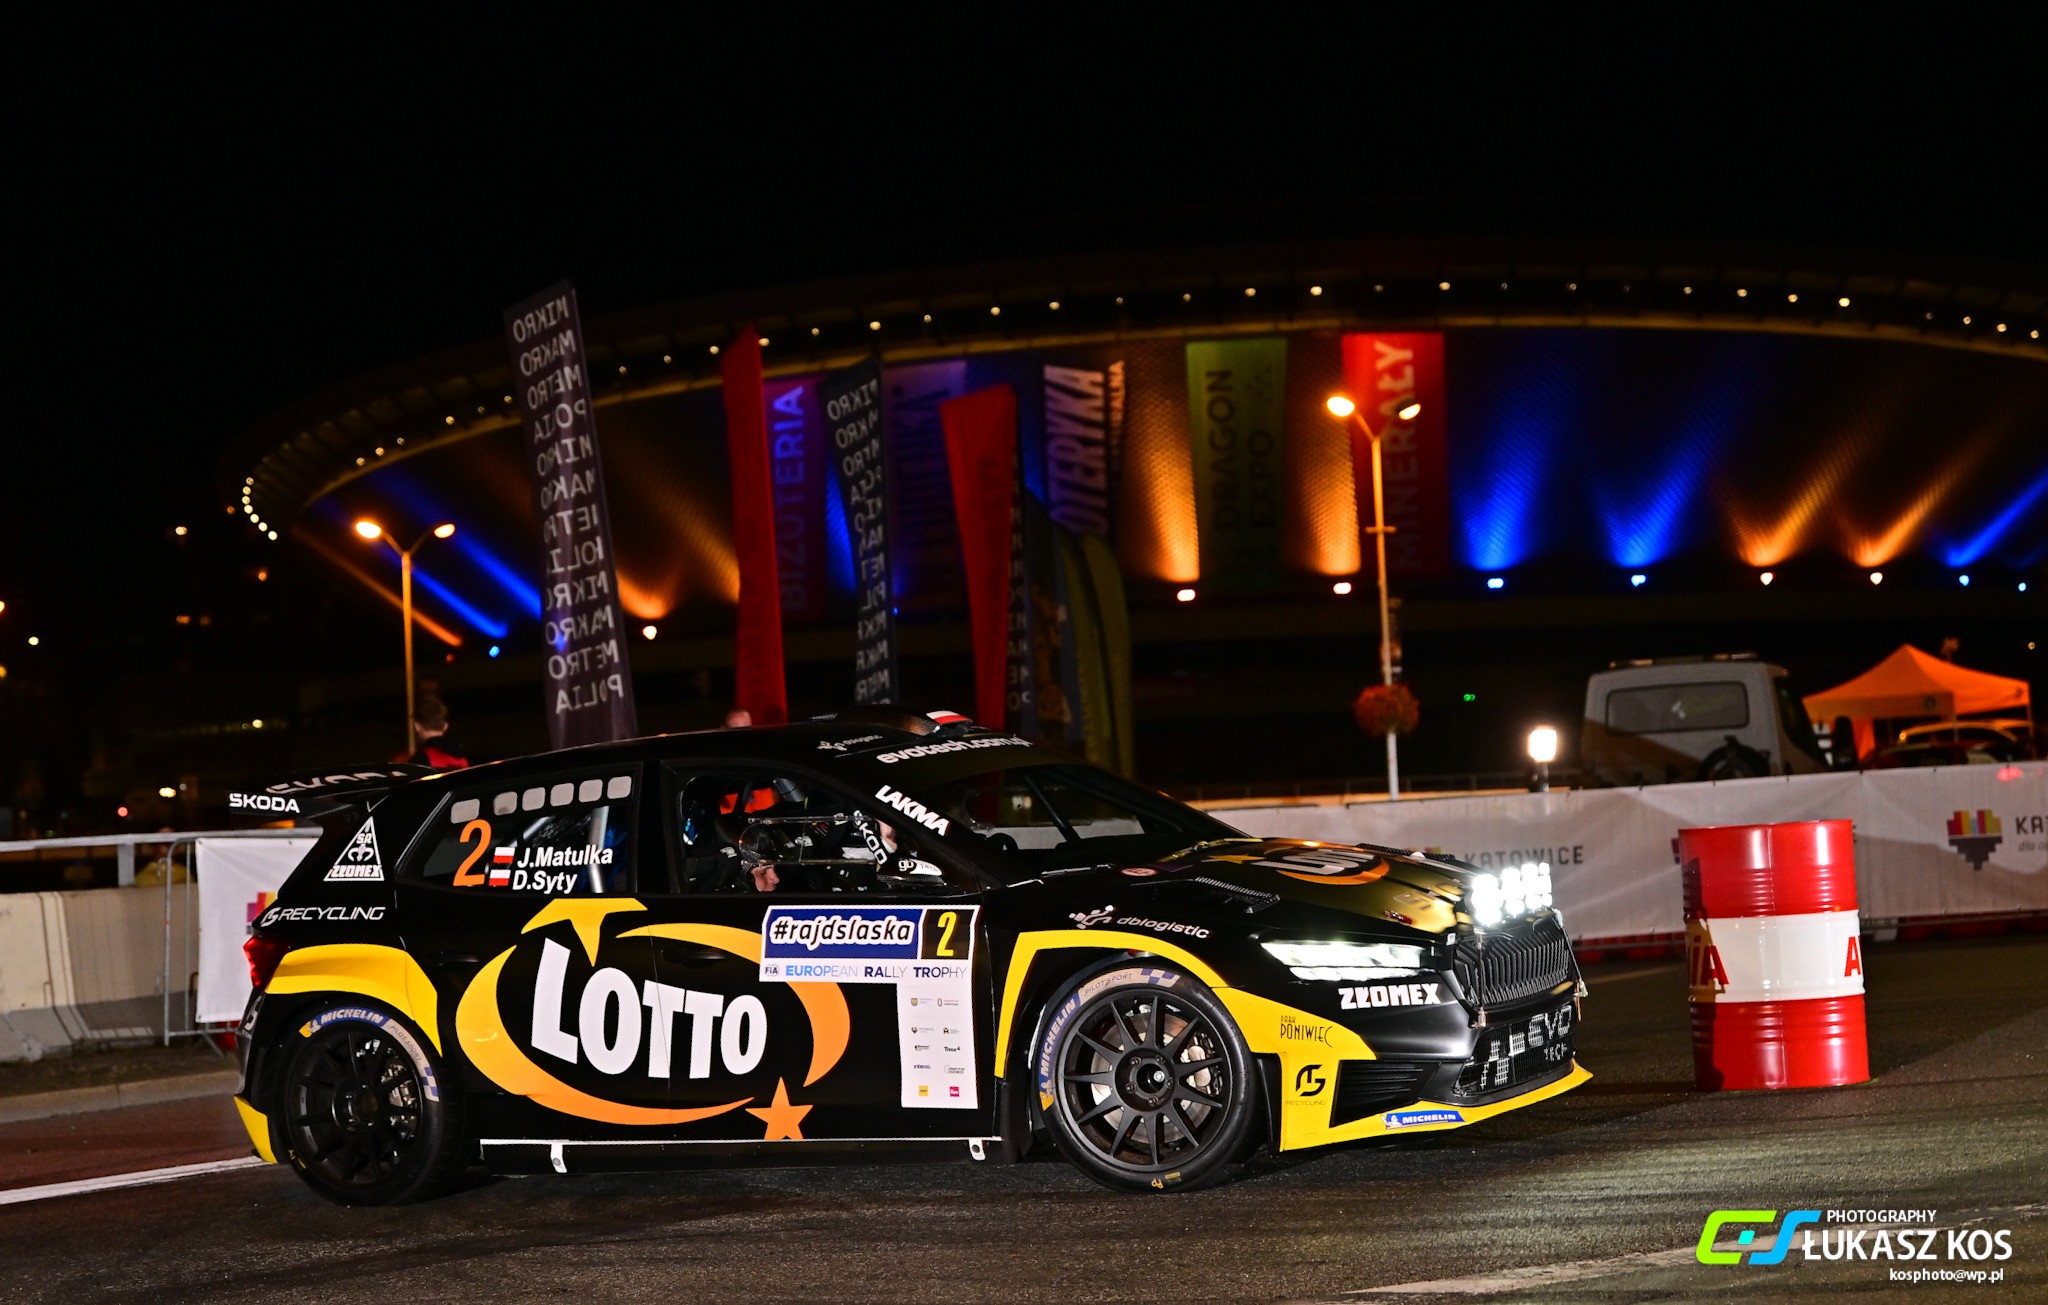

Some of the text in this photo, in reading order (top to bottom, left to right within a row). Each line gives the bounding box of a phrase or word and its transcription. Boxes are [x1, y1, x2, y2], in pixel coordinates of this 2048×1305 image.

[1206, 369, 1240, 528] DRAGON
[1248, 429, 1275, 527] EXPO
[772, 385, 806, 613] BIZUTERIA
[875, 785, 950, 836] LAKMA
[453, 819, 492, 886] 2
[517, 845, 613, 868] J.Matulka
[512, 870, 578, 894] D.Syty
[278, 907, 386, 920] RECYCLING
[773, 911, 957, 957] #rajdslaska 2
[1117, 917, 1210, 939] dblogistic
[785, 965, 968, 978] EUROPEAN RALLY TROPHY
[1084, 972, 1133, 996] PILOT SPORT
[531, 937, 767, 1079] LOTTO
[1338, 983, 1442, 1010] ZŁOMEX
[320, 1008, 384, 1024] MICHELIN
[1040, 998, 1076, 1077] MICHELIN
[1281, 1023, 1333, 1048] PONIWIEC
[1402, 1112, 1458, 1124] MICHELIN
